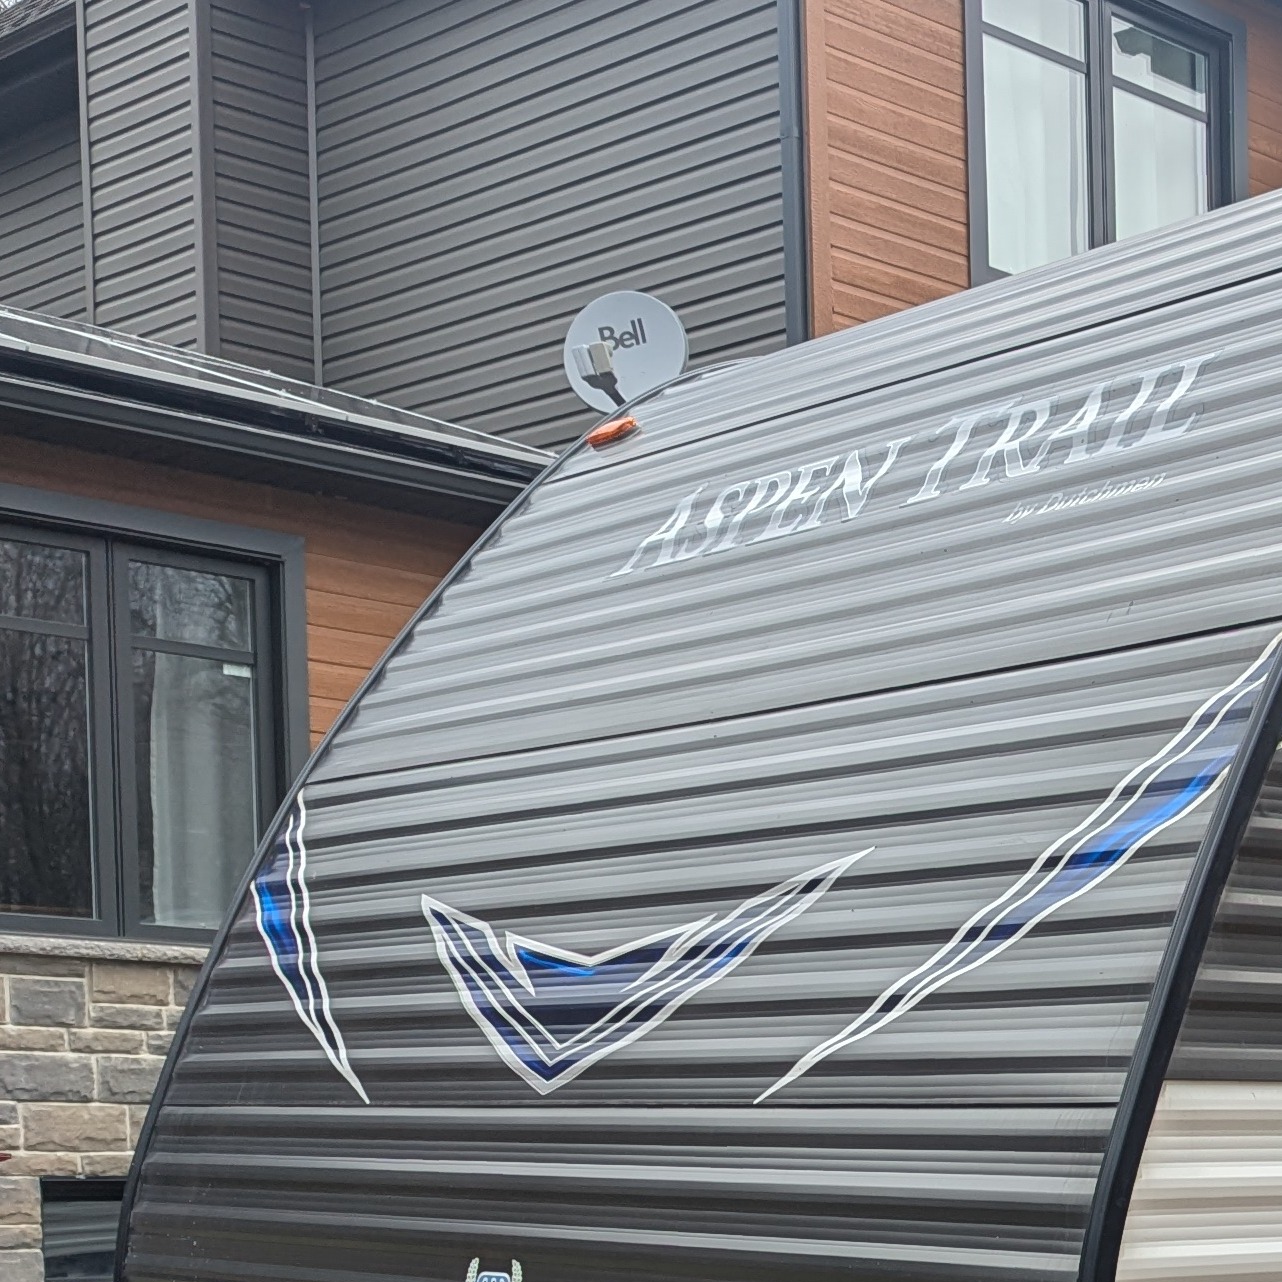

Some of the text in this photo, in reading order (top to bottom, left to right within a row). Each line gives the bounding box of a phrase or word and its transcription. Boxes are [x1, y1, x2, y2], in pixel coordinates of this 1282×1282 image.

[598, 317, 647, 351] Bell
[603, 348, 1223, 580] ASPEN TRAIL
[1001, 472, 1167, 524] by Dutchmen
